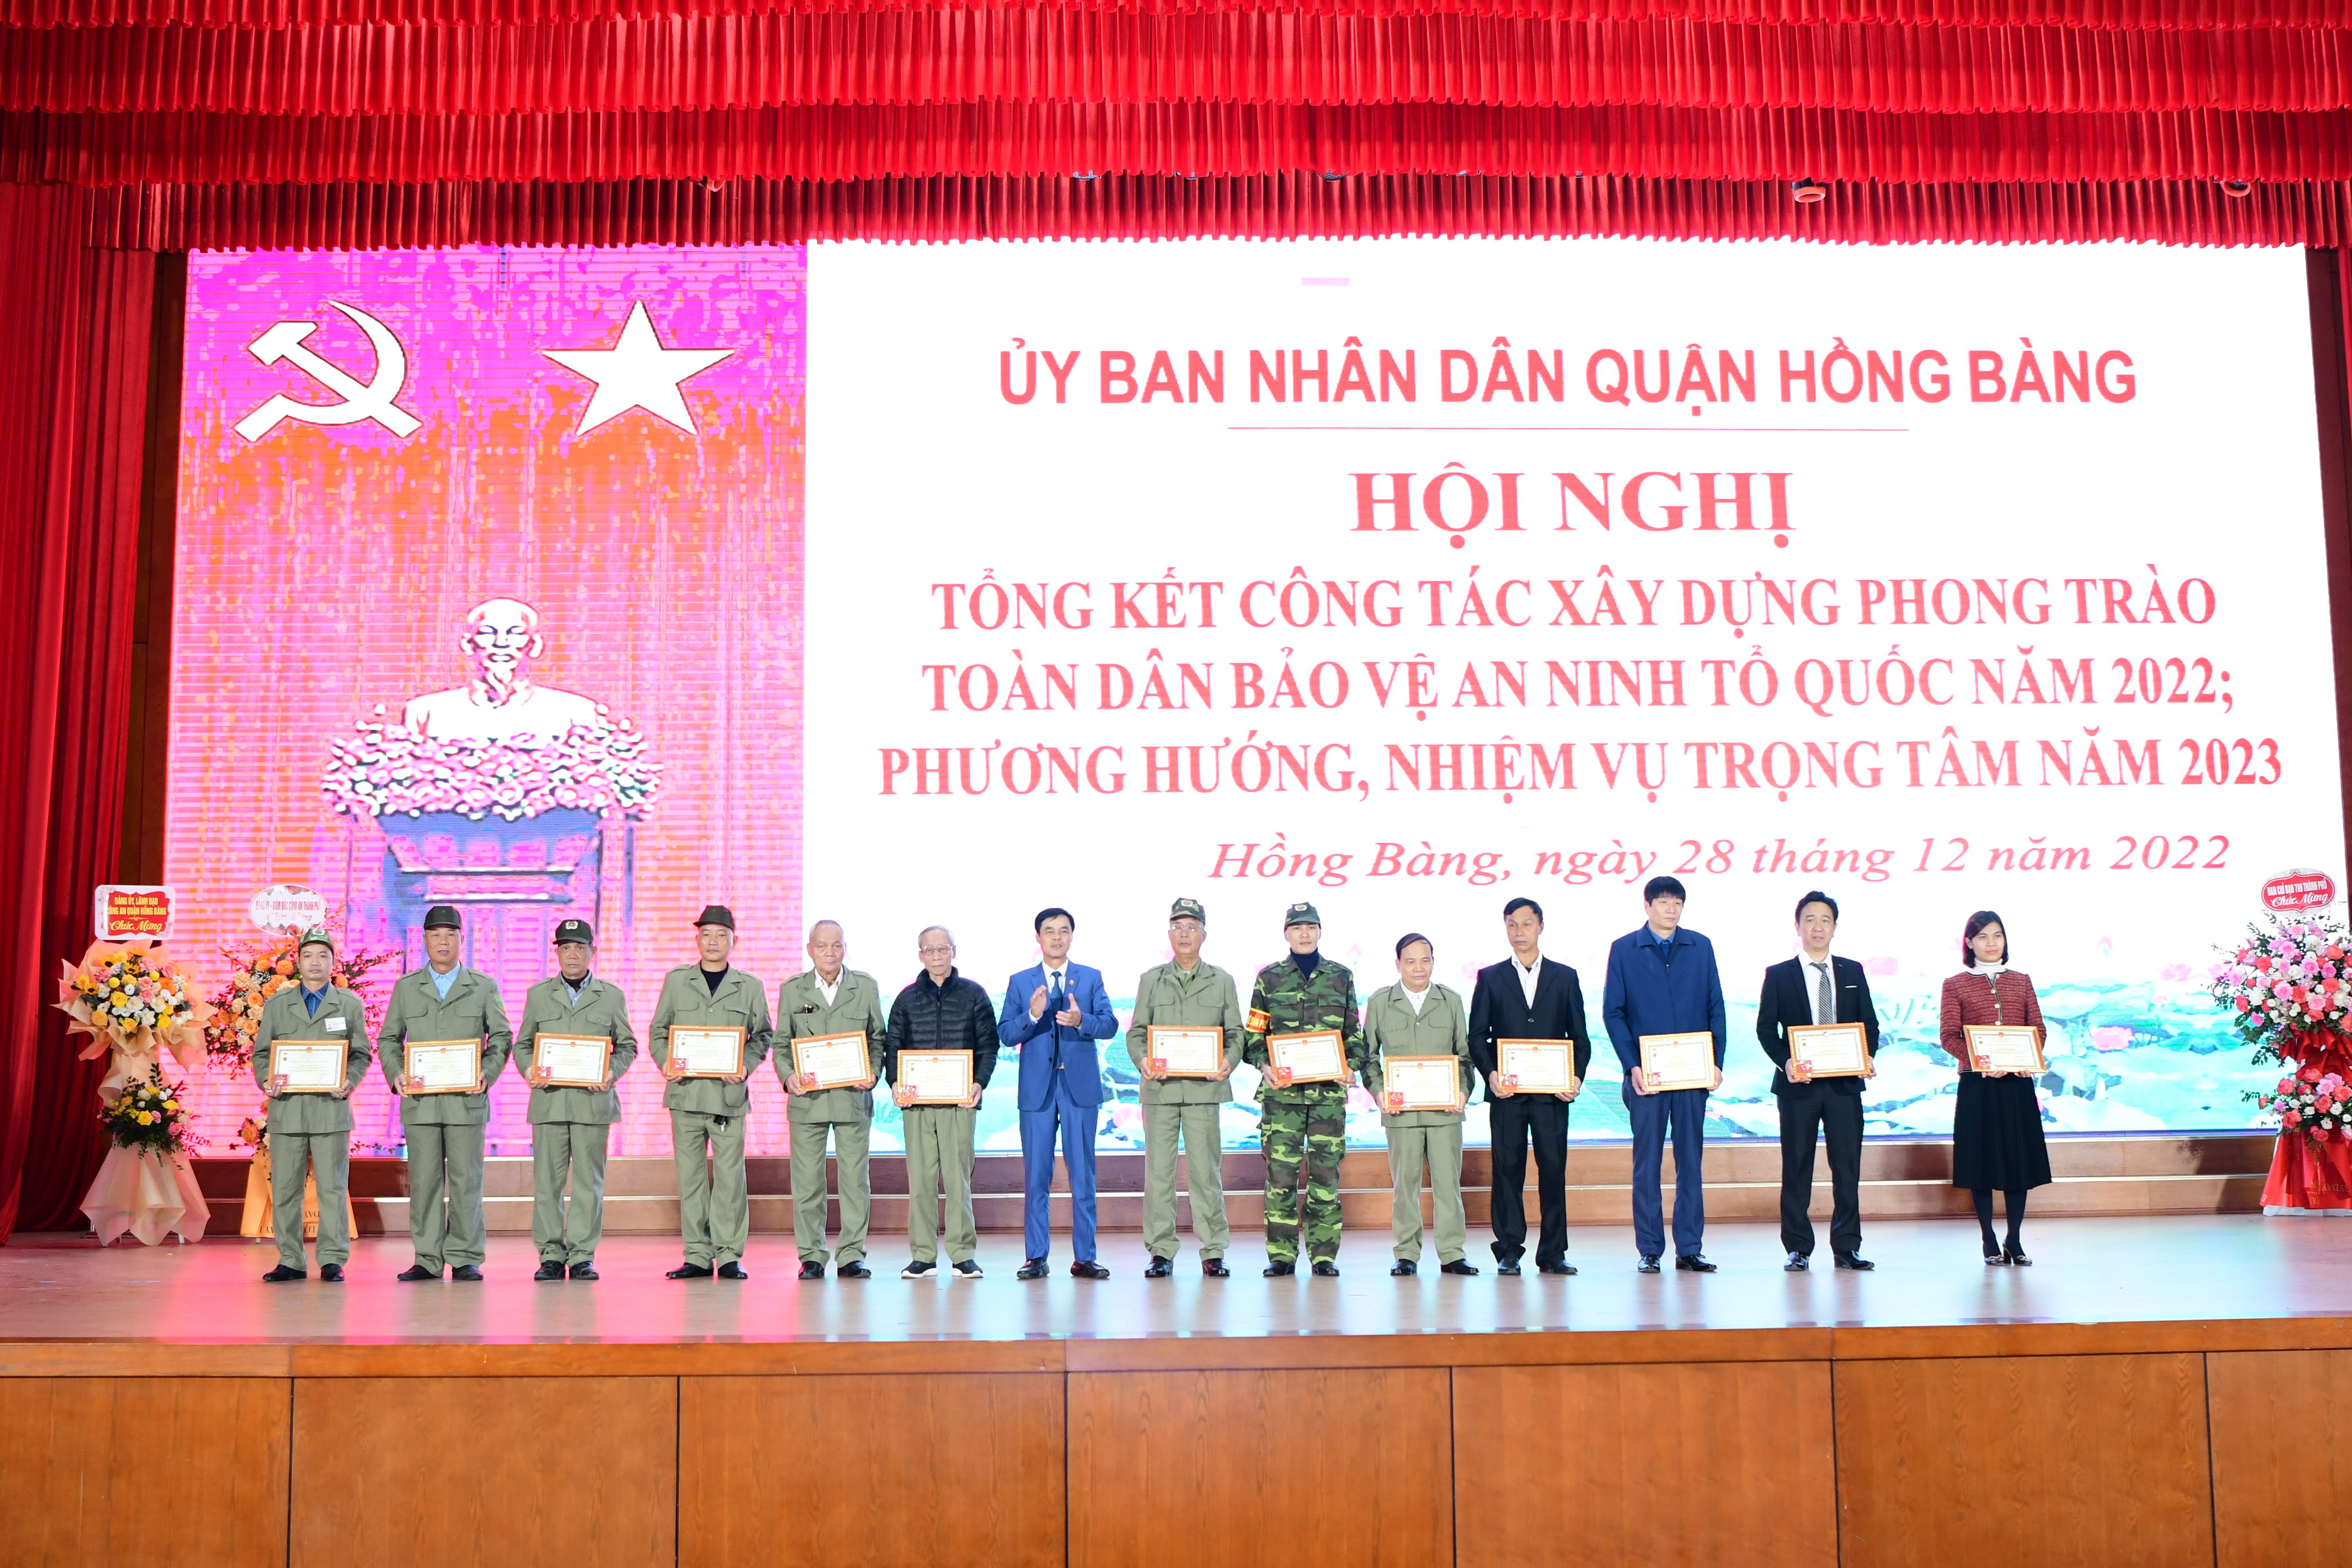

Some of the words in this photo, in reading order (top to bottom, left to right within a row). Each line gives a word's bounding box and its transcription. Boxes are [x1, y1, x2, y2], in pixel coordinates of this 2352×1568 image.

[1000, 337, 1081, 405] ỦY
[1099, 349, 1224, 404] BAN
[1249, 336, 1416, 403] NHÂN
[1440, 336, 1565, 403] DÂN
[1585, 343, 1756, 417] QUẬN
[1779, 336, 1951, 404] HỒNG
[1968, 337, 2136, 404] BÀNG
[1347, 461, 1528, 550] HỘI
[1551, 471, 1797, 549] NGHỊ
[931, 568, 1094, 630] TỔNG
[1109, 567, 1223, 629] KẾT
[1239, 565, 1404, 628] CÔNG
[1417, 565, 1531, 627] TÁC
[1547, 564, 1665, 626] XÂY
[1677, 571, 1841, 639] DỰNG
[1855, 577, 2052, 625] PHONG
[2063, 563, 2216, 624] TRÀO
[921, 649, 1080, 712] TOÀN
[1095, 648, 1215, 710] DÂN
[1229, 646, 1349, 709] BẢO
[1361, 653, 1438, 721] VỆ
[1451, 661, 1529, 708] AN
[1543, 660, 1688, 707] NINH
[1700, 644, 1779, 707] TỔ
[1794, 644, 1954, 718] QUỐC
[1968, 644, 2098, 705] NĂM
[2112, 657, 2233, 714] 2022;
[877, 738, 1127, 795] PHƯƠNG
[1141, 729, 1369, 803] HƯỚNG,
[1383, 735, 1578, 804] NHIỆM
[1590, 742, 1669, 803] VỤ
[1683, 740, 1884, 803] TRỌNG
[1896, 726, 2023, 787] TÂM
[2036, 726, 2164, 786] NĂM
[2179, 737, 2282, 786] 2023
[1207, 832, 1354, 887] Hồng
[1365, 841, 1511, 886] Bàng,
[1534, 839, 1657, 884] ngày
[1672, 839, 1735, 874] 28
[1752, 838, 1895, 883] tháng
[1913, 837, 1970, 872] 12
[1987, 836, 2091, 871] năm
[2109, 835, 2230, 870] 2022
[110, 920, 134, 931] Chúc
[133, 920, 163, 933] Mừng
[119, 907, 127, 915] AN
[2270, 896, 2297, 907] Chúc
